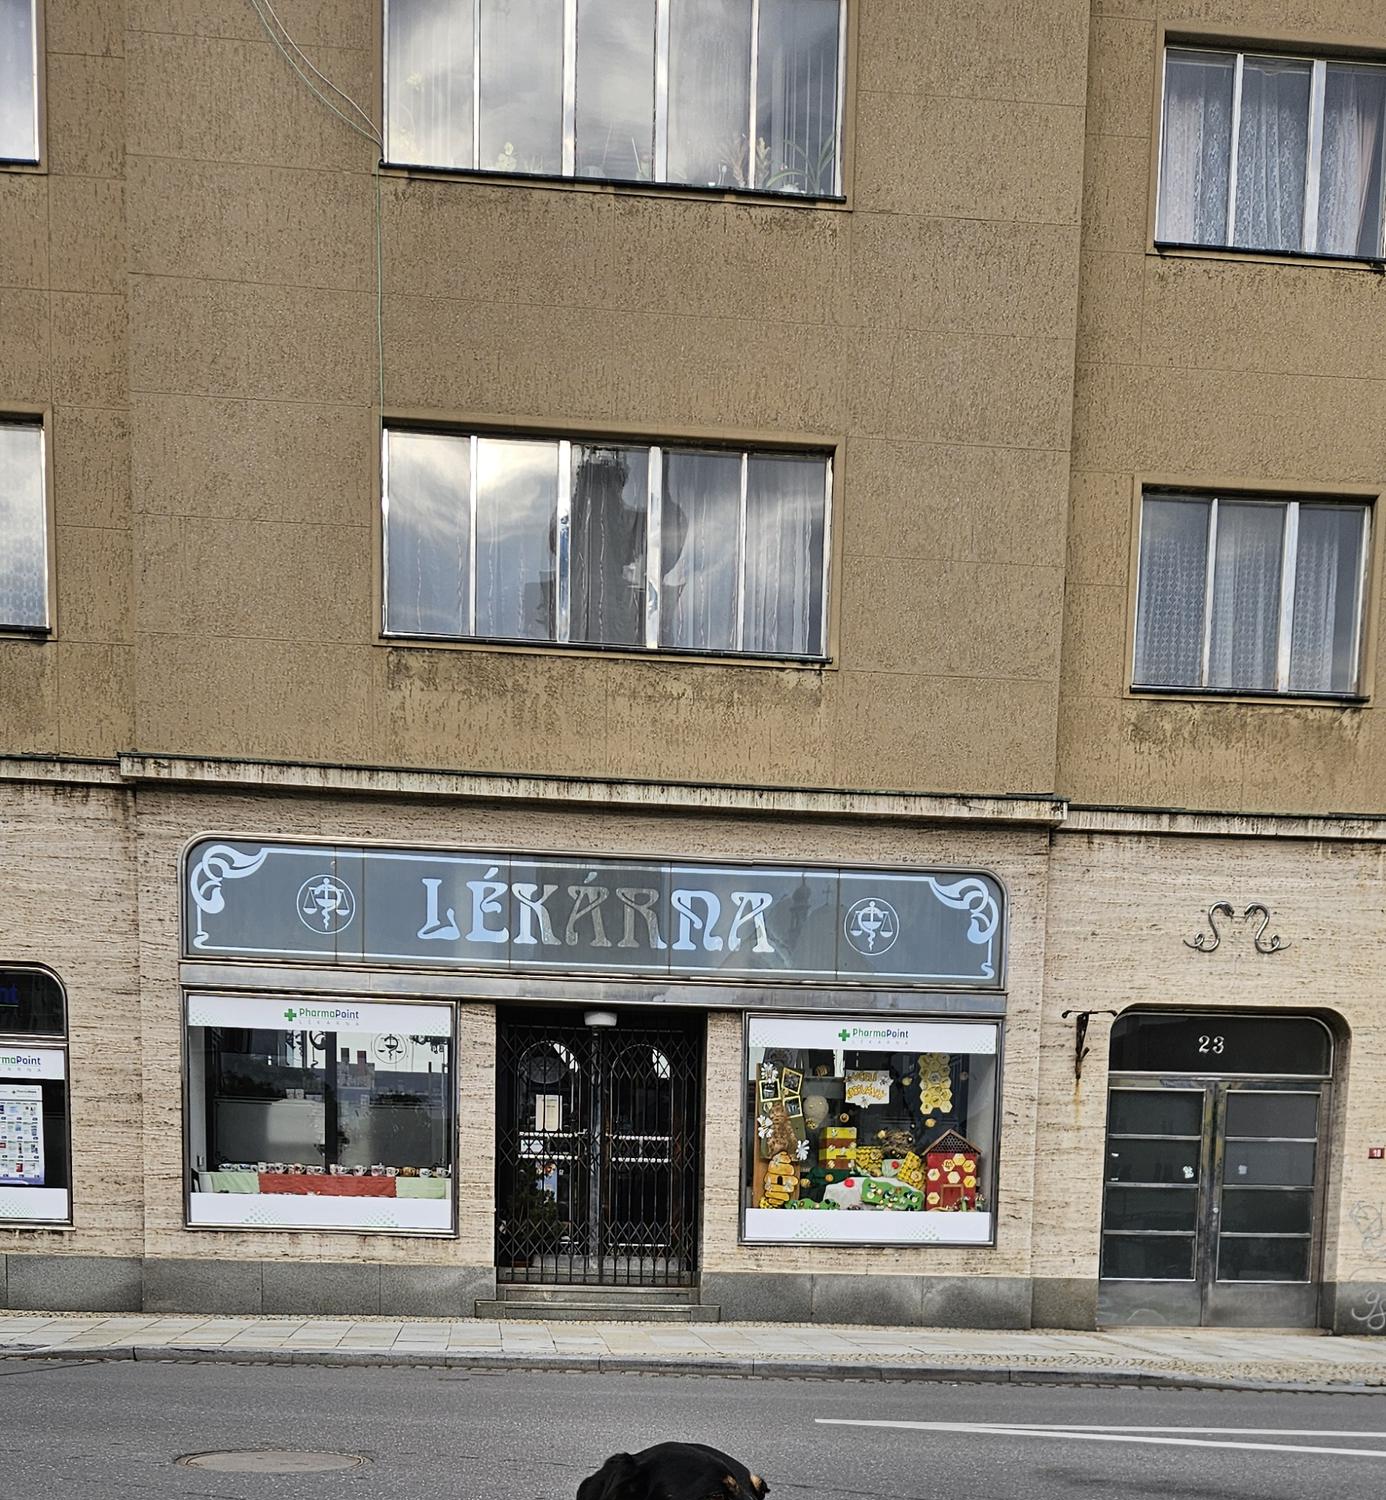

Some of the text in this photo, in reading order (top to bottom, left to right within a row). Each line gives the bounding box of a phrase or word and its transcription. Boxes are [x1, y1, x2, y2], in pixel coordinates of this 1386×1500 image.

[416, 866, 775, 953] LÉKÁRNA
[299, 1008, 359, 1019] PharmaPoint
[853, 1028, 909, 1039] PharmaPoint
[1199, 1035, 1225, 1054] 23
